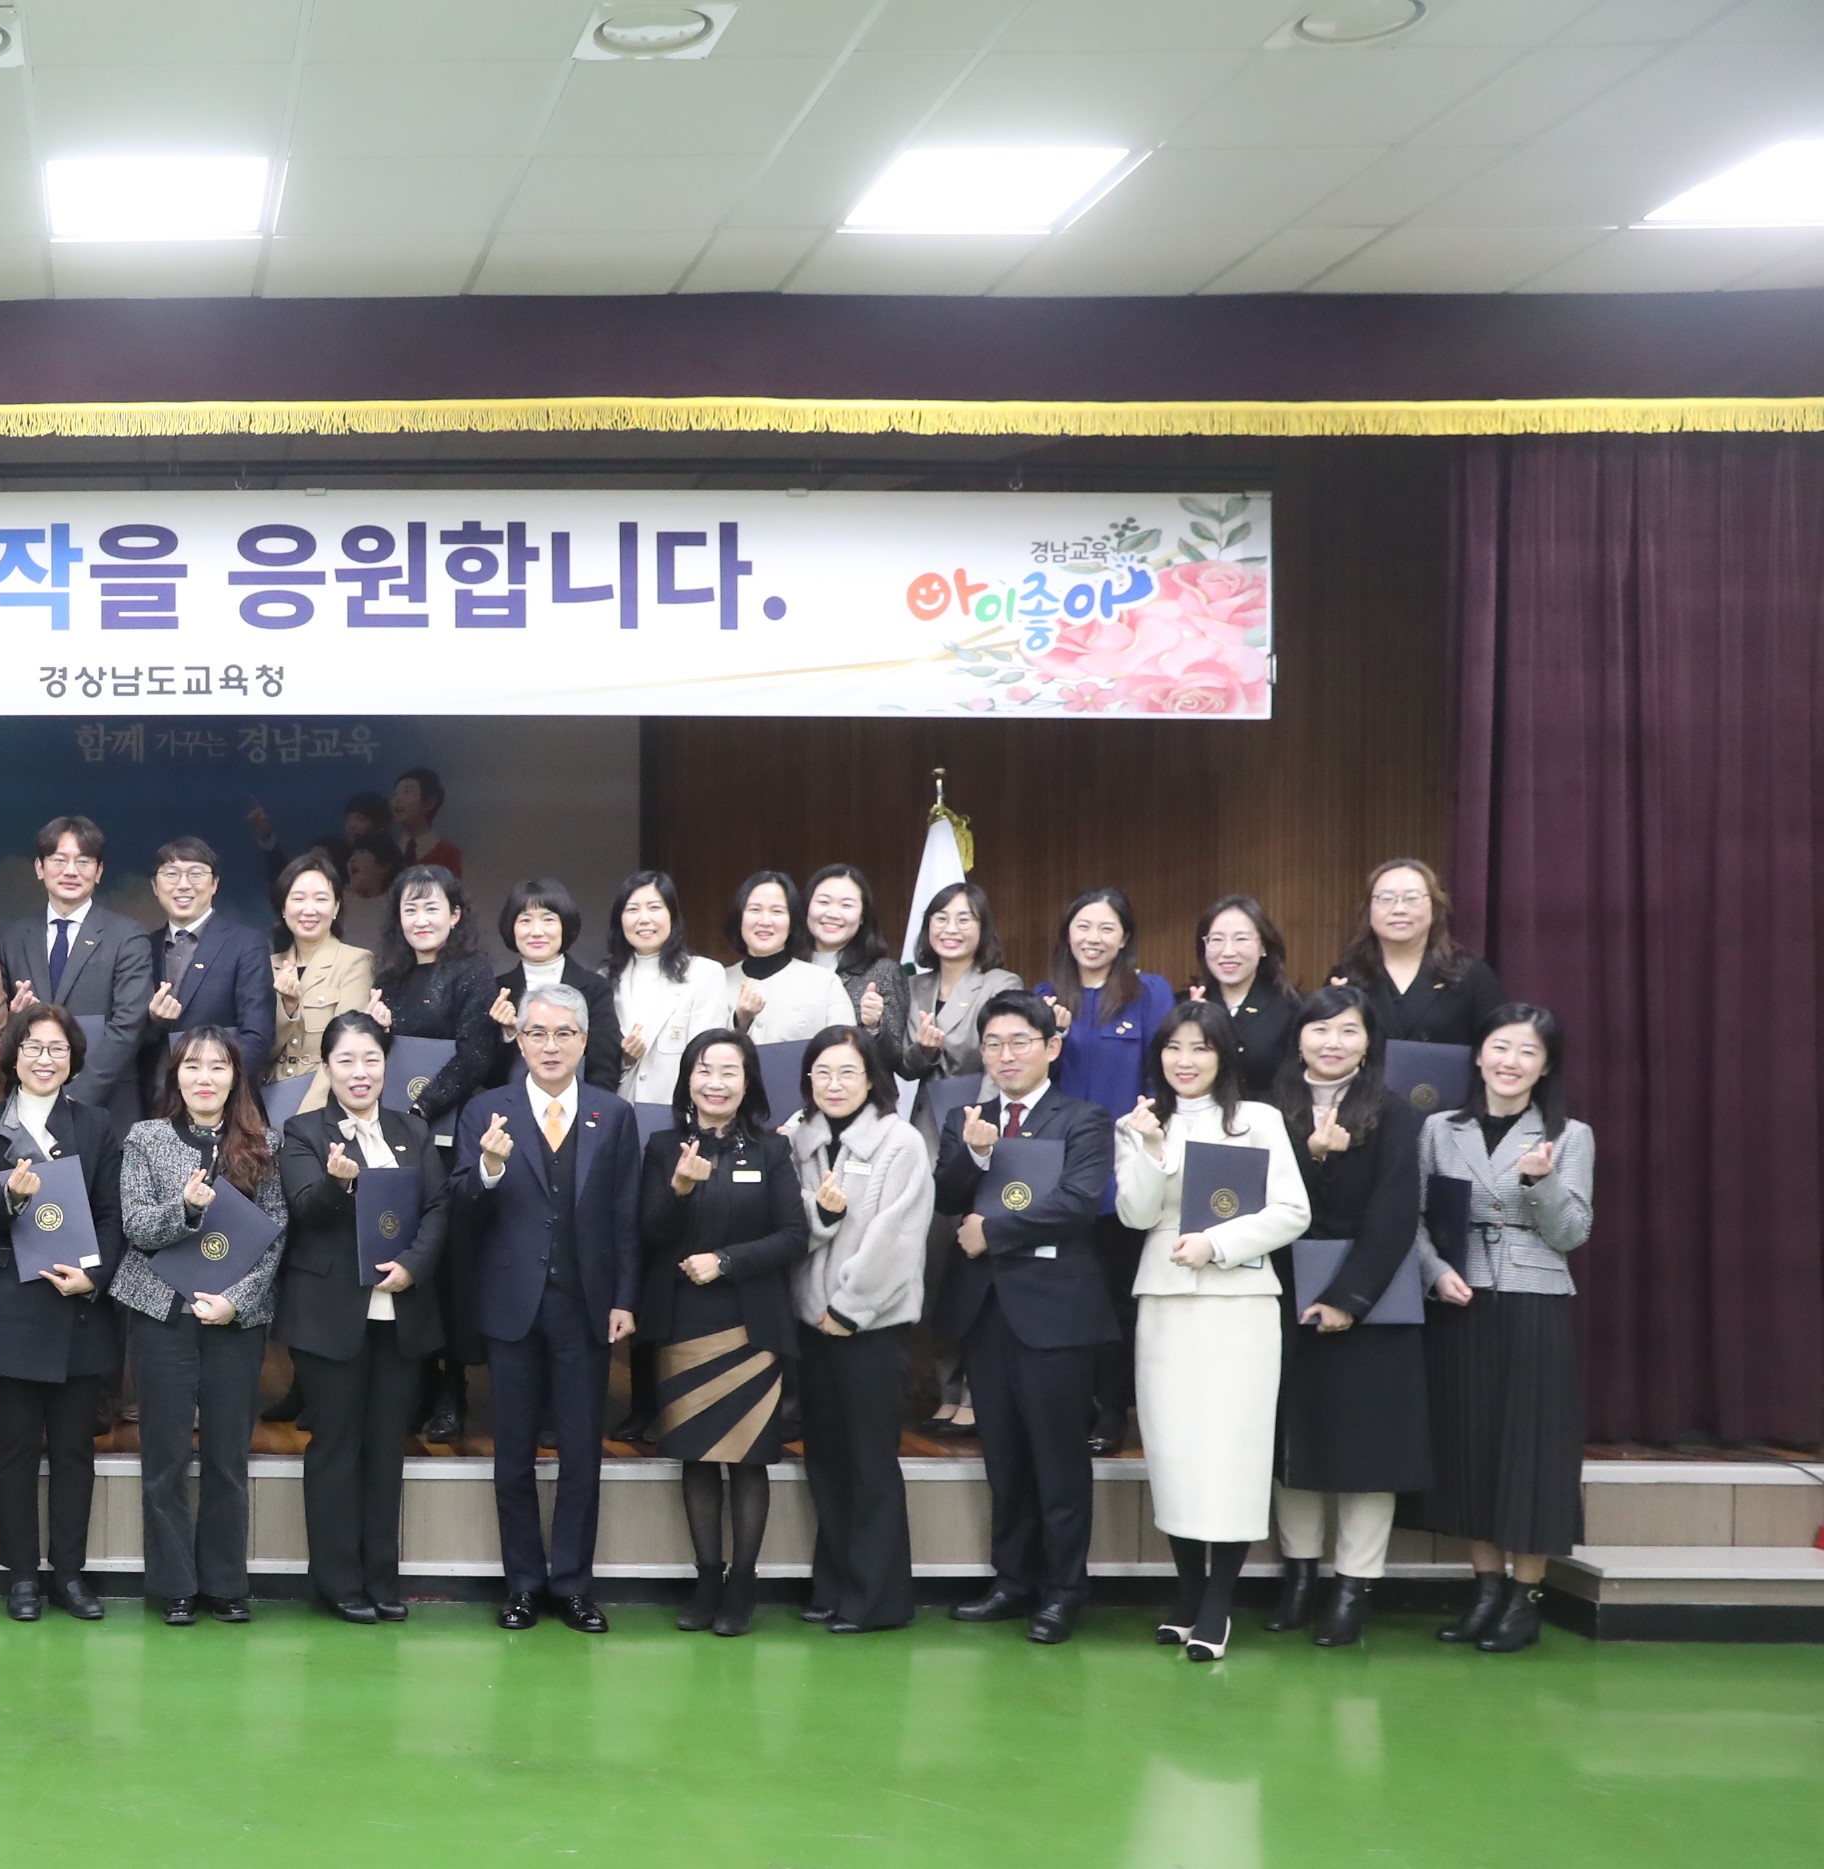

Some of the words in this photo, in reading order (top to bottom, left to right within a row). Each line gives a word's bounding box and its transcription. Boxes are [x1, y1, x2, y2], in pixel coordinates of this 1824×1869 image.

[1030, 540, 1110, 564] 경남교육
[227, 520, 787, 631] 응원합니다.
[906, 565, 1155, 652] 아이좋아
[39, 663, 284, 699] 경상남도교육청
[75, 722, 145, 764] 함께
[155, 729, 227, 758] 가꾸는
[237, 722, 381, 765] 경남교육
